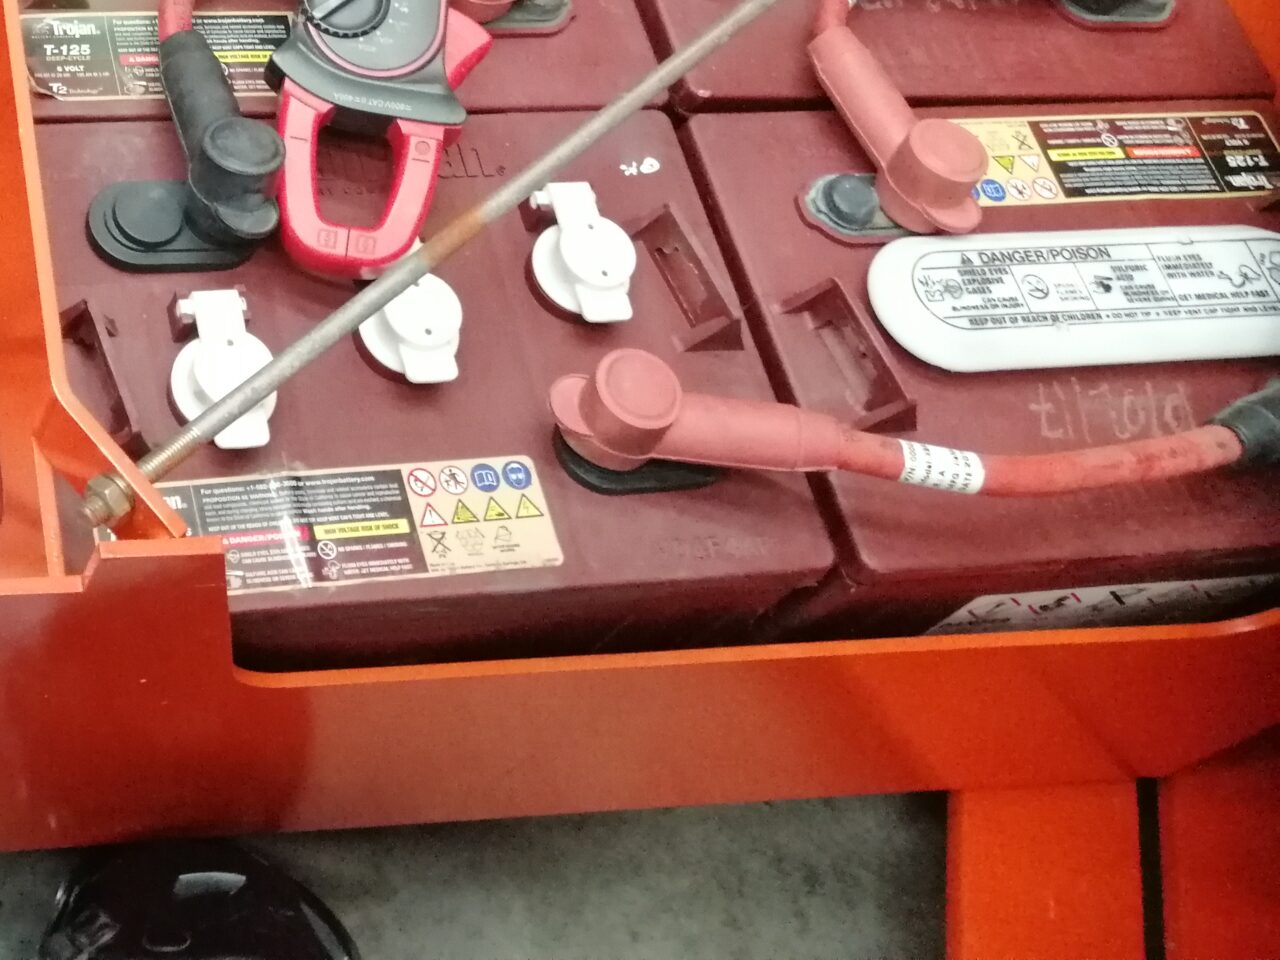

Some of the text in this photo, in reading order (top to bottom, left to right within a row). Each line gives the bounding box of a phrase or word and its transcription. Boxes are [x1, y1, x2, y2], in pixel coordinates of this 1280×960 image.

[51, 20, 96, 38] Trojan
[44, 44, 91, 55] T-125
[1226, 154, 1270, 167] T-125
[1224, 171, 1274, 190] Trojan
[978, 247, 1112, 265] DANGER/POISON
[1183, 253, 1202, 261] EYES
[1161, 262, 1213, 270] IMMEDIATELY
[957, 267, 1009, 276] SHIELD EYES
[1189, 270, 1215, 278] WATER
[961, 277, 1005, 286] EXPLOSIVE
[1195, 292, 1229, 300] MEDICAL
[1251, 290, 1270, 298] FAST
[968, 318, 990, 326] KEEP
[991, 317, 1008, 325] OUT
[1021, 315, 1049, 323] REACH
[1050, 314, 1060, 323] OF
[1062, 313, 1103, 322] CHILDREN
